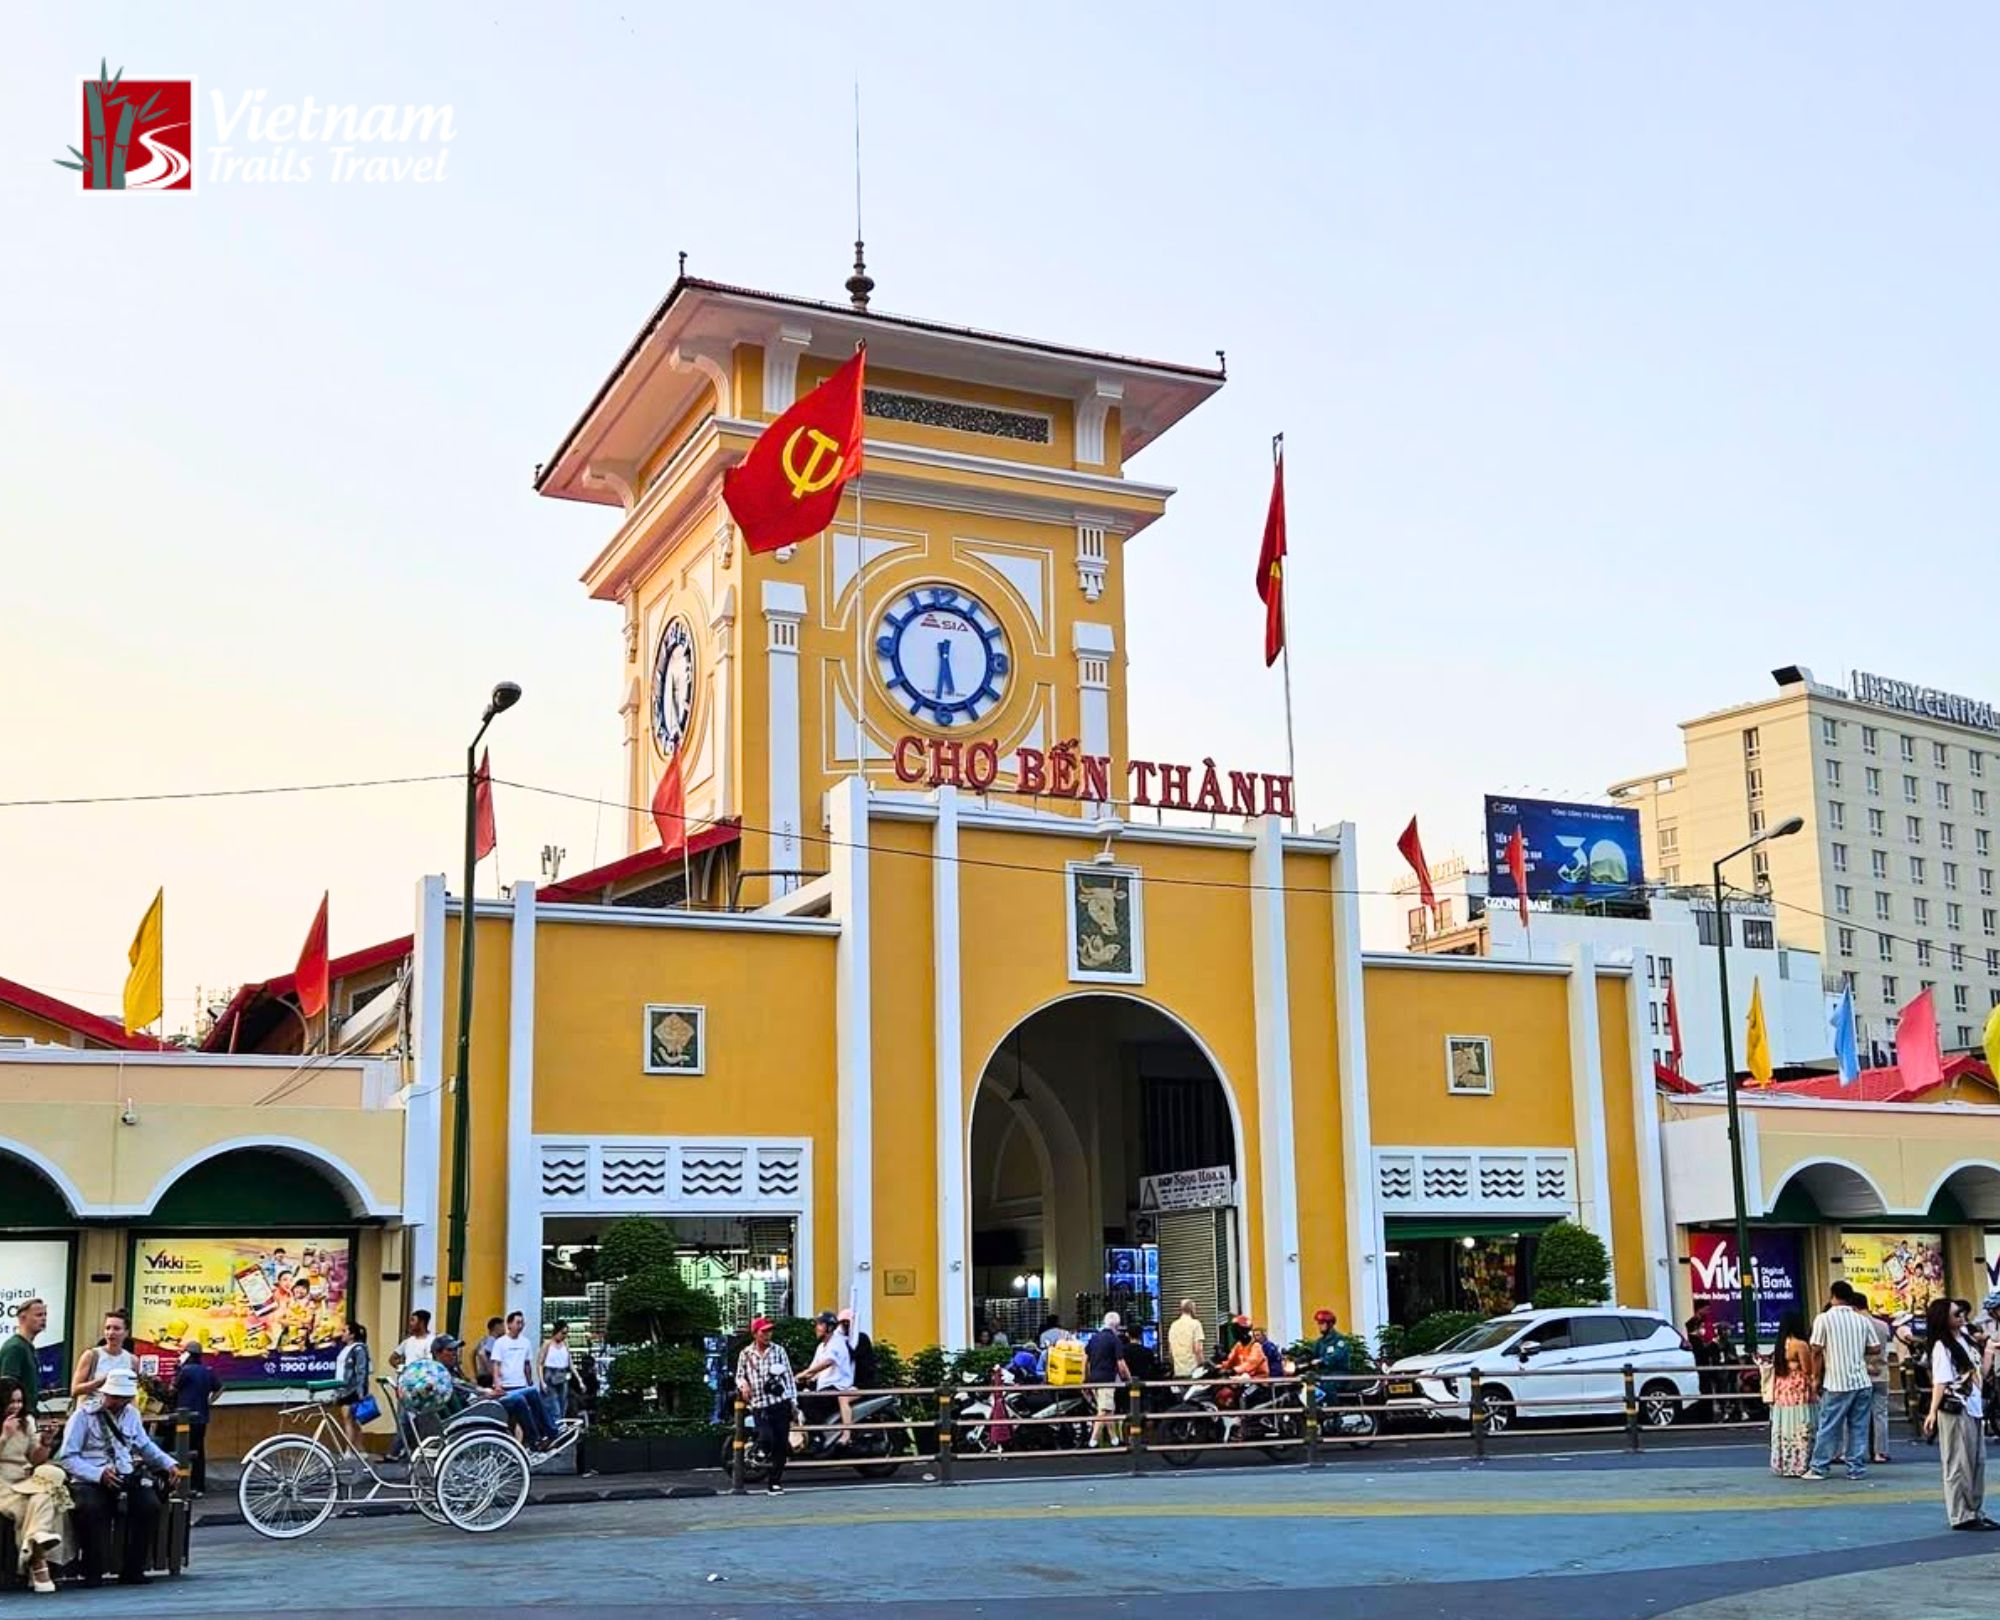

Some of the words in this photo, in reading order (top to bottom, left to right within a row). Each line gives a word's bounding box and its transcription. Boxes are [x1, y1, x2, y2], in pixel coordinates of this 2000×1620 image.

[893, 735, 999, 795] CHỢ
[1016, 738, 1111, 801] BẾN
[1127, 757, 1294, 818] THÀNH
[1555, 835, 1628, 887] 30
[145, 1249, 184, 1269] Vikki
[1761, 1267, 1785, 1276] Digital
[1762, 1276, 1792, 1288] Bank
[0, 1288, 36, 1300] igital
[143, 1283, 167, 1294] TIẾT
[170, 1284, 196, 1295] KIỆM
[199, 1285, 225, 1294] Vikki
[280, 1362, 306, 1372] 1900
